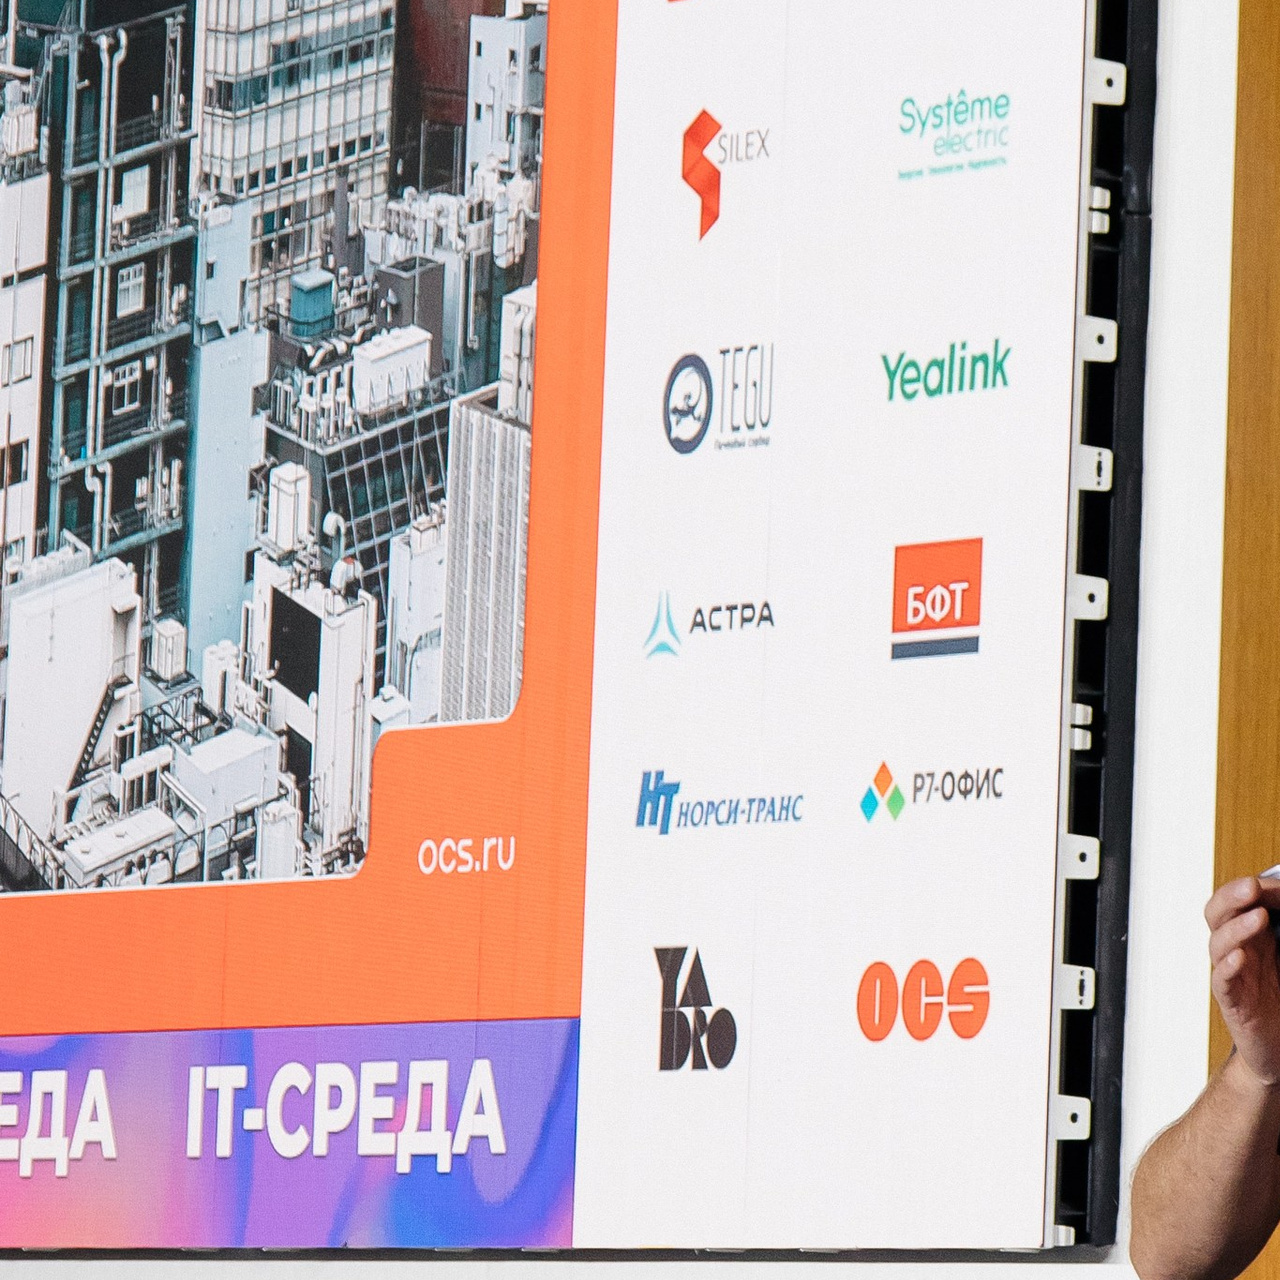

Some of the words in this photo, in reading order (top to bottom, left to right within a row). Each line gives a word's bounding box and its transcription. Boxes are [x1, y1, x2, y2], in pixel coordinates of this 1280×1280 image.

[717, 128, 770, 165] SILEX
[719, 345, 773, 432] TEGU
[882, 339, 1010, 401] Yealink
[690, 602, 774, 633] АСТРА
[906, 581, 970, 626] БФТ
[913, 768, 1003, 802] Р7-ОФИС
[677, 794, 804, 828] НОРСИ-ТРАНС
[418, 837, 515, 874] ocs.ru
[856, 957, 991, 1042] OCS
